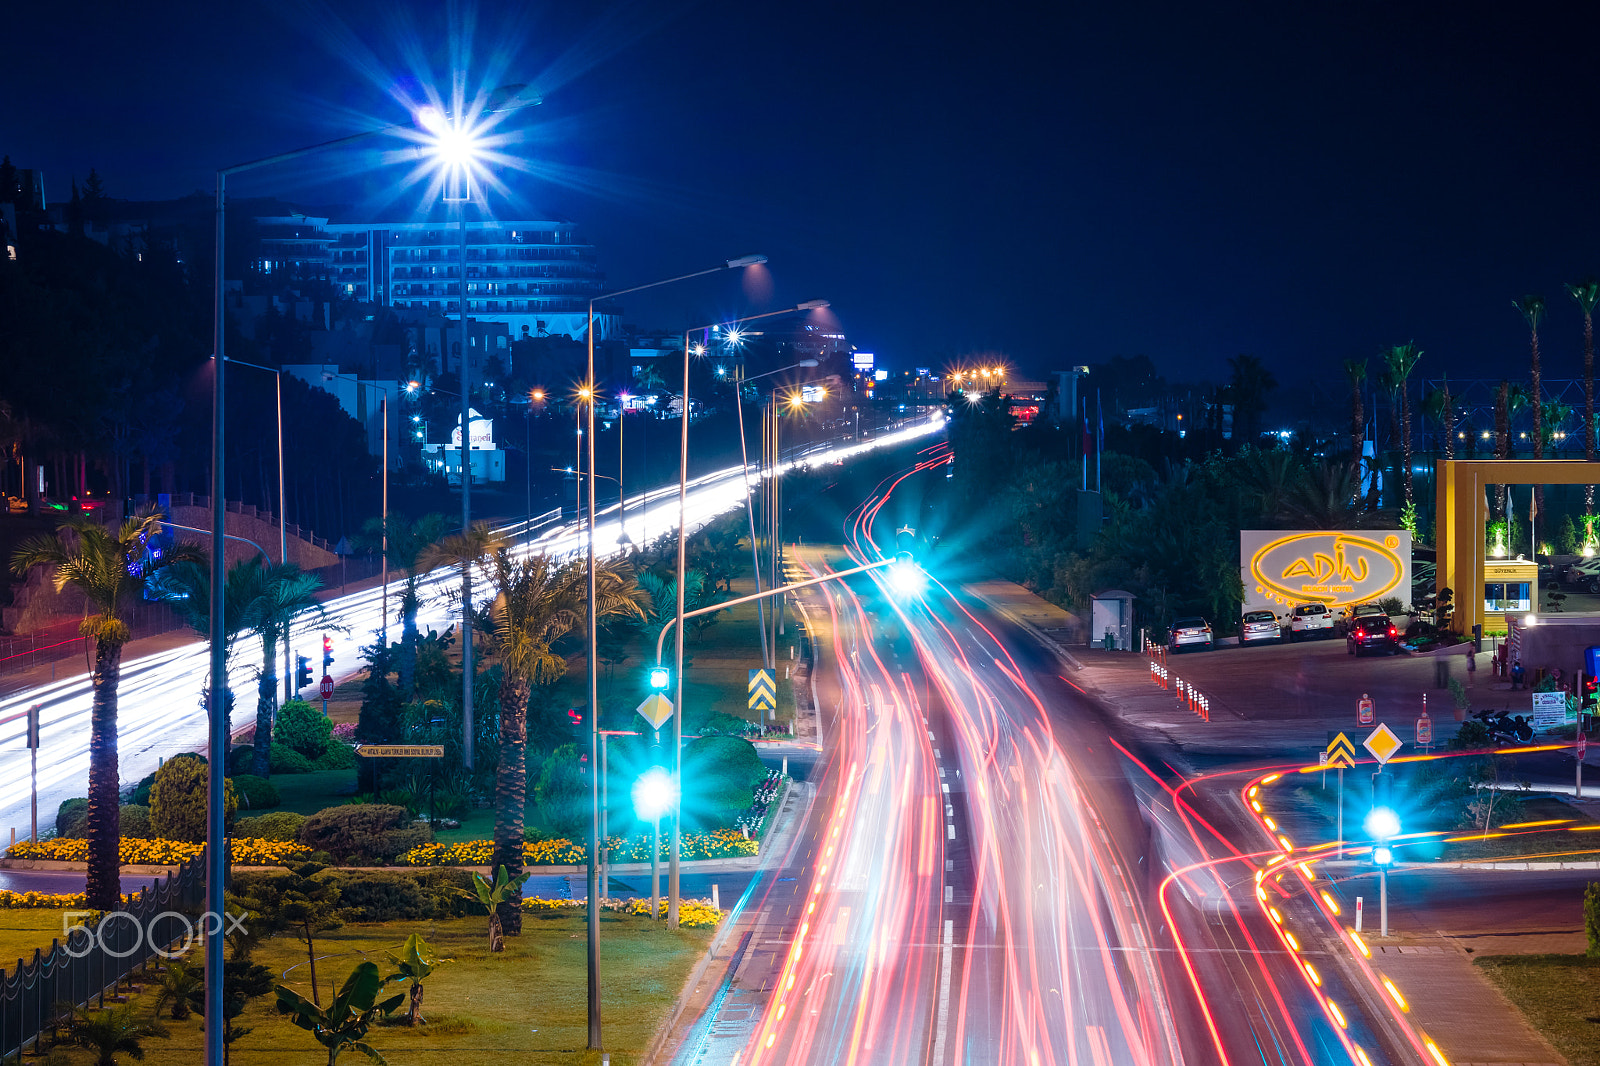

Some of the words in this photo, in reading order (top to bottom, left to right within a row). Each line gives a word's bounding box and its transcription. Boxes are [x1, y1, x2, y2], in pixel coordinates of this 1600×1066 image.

[1302, 584, 1328, 593] BEACH
[1329, 584, 1354, 593] HOTEL
[321, 682, 332, 692] DUR
